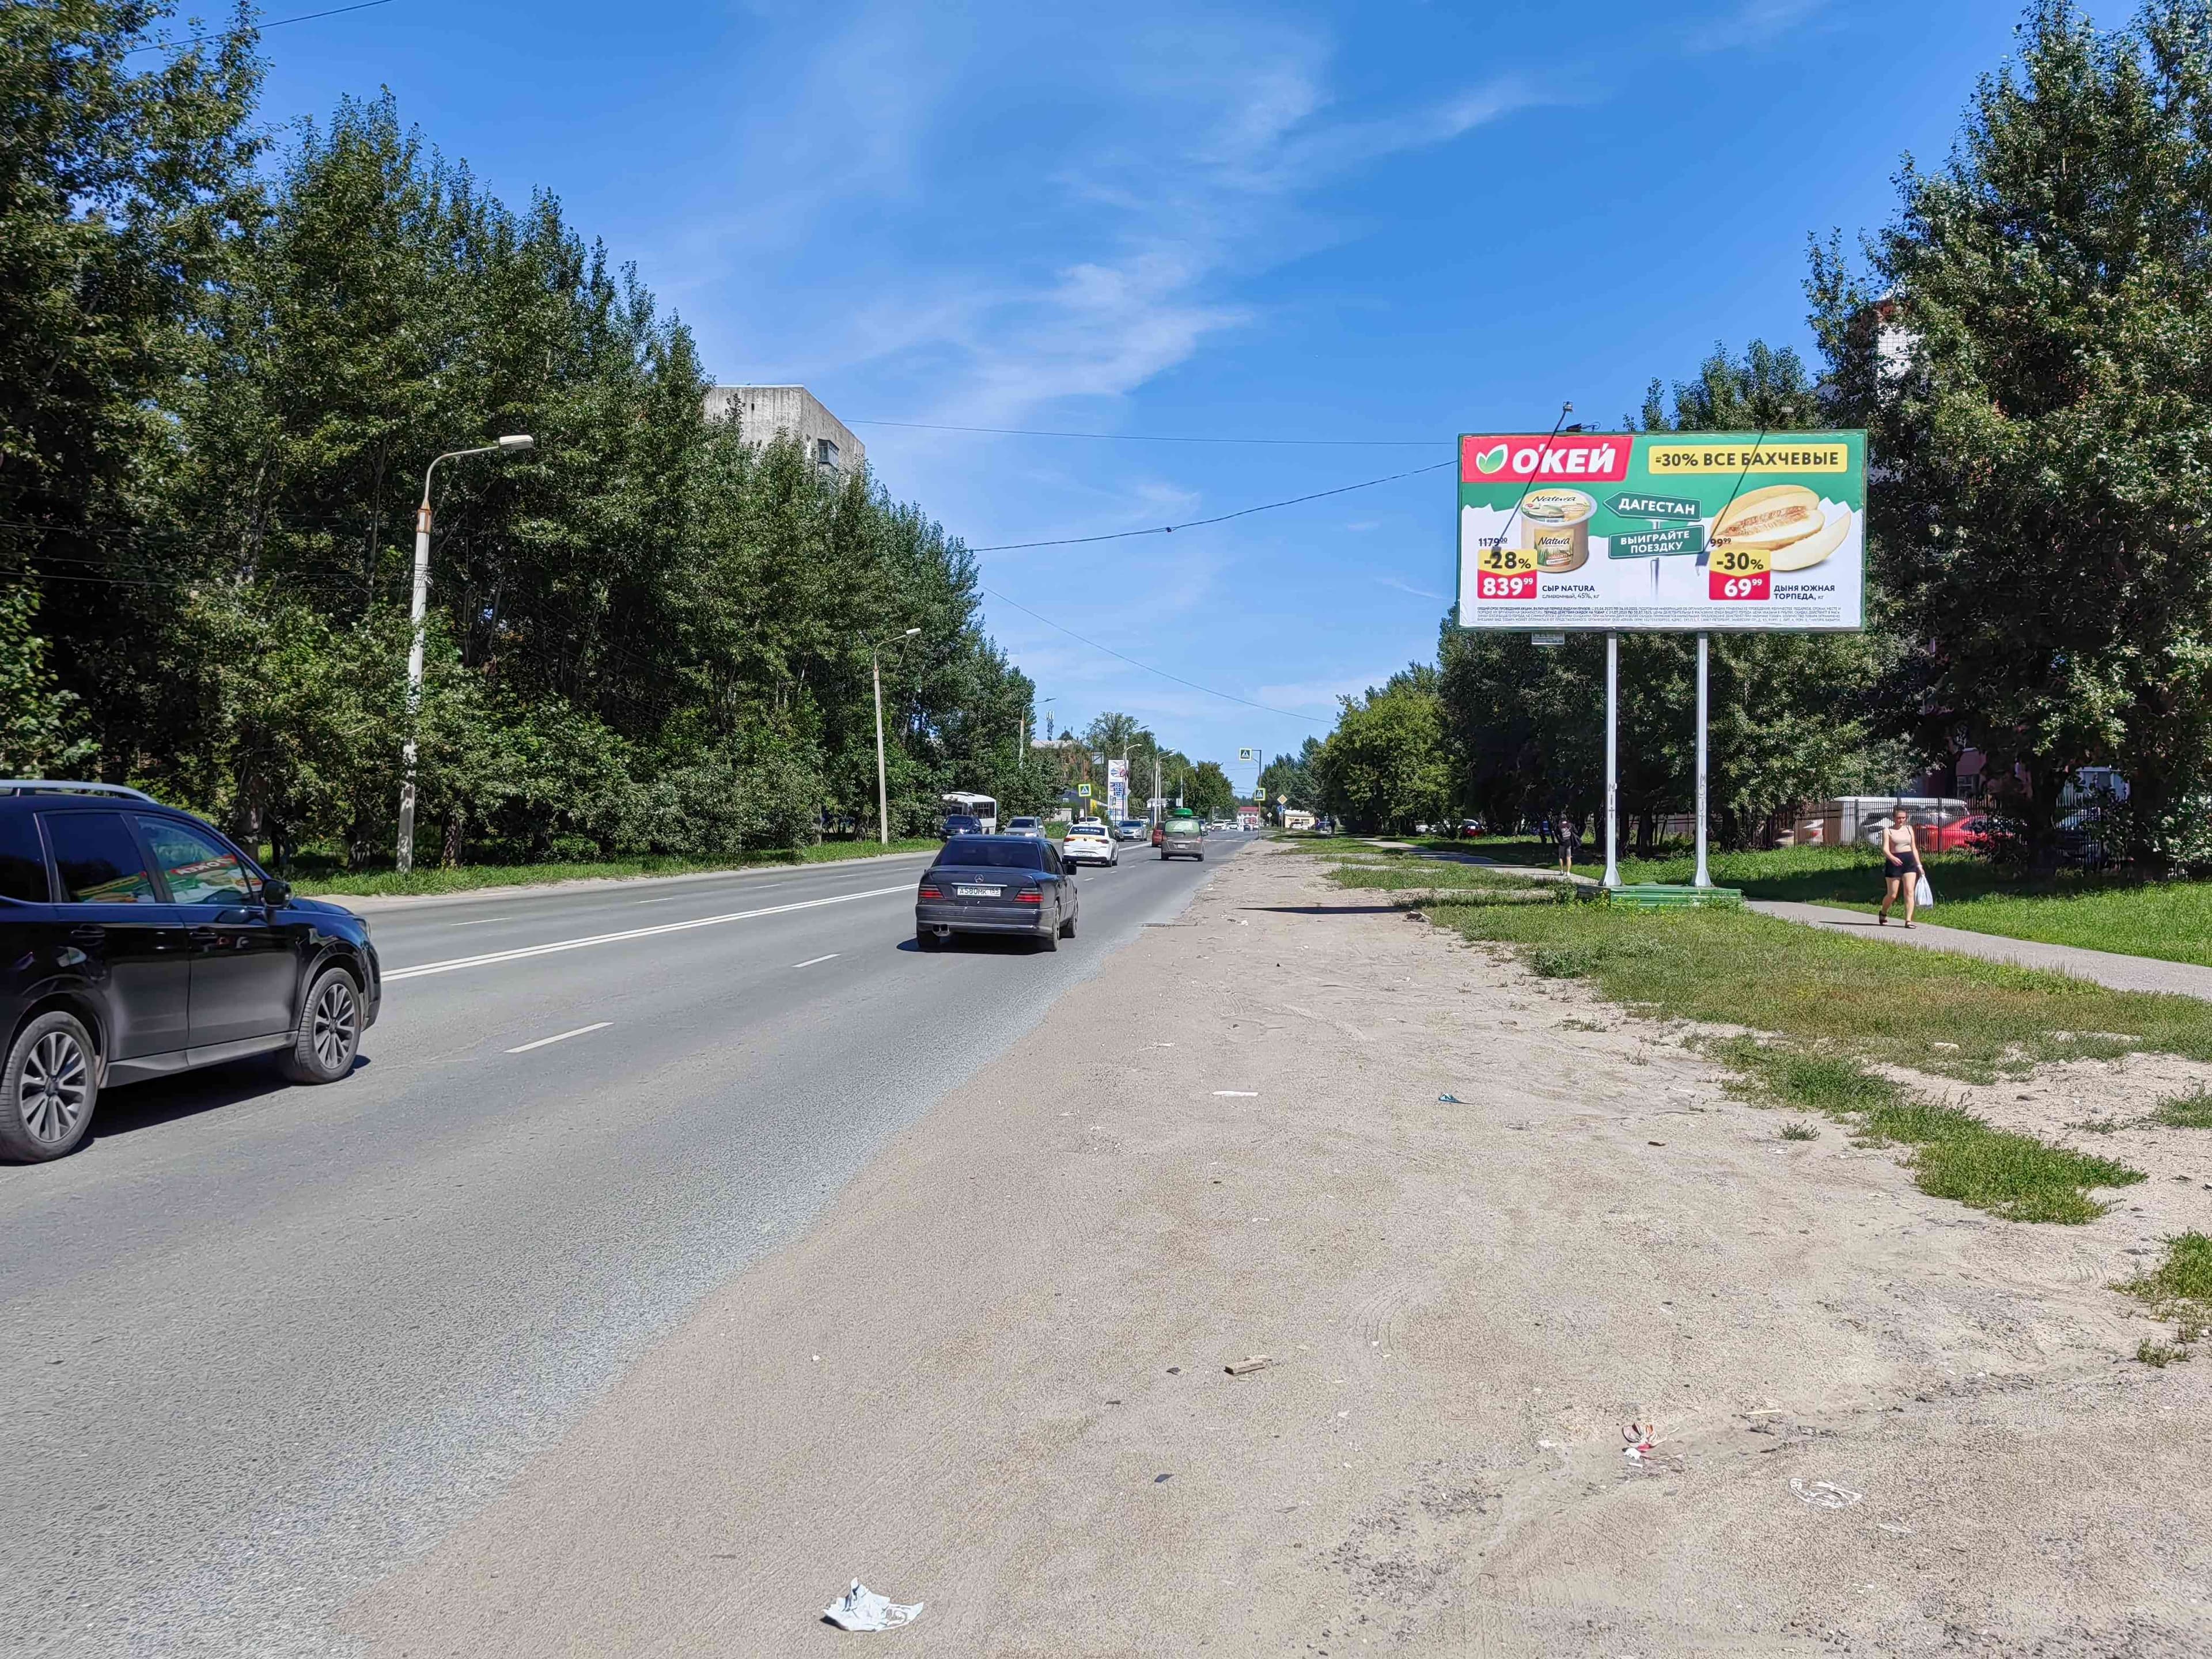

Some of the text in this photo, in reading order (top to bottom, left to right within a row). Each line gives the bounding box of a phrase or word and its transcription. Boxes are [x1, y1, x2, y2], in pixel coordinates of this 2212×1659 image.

[1703, 453, 1736, 466] ВСЕ
[1741, 452, 1839, 465] БАХЧЕВЫЕ
[1619, 498, 1695, 515] ДАГЕСТАН
[1538, 537, 1570, 546] Natura
[1620, 531, 1690, 545] ВЫИГРАЙТЕ
[1631, 541, 1683, 554] ПОЕЗДКУ
[1484, 551, 1532, 569] -28%
[1717, 552, 1764, 570] -30%
